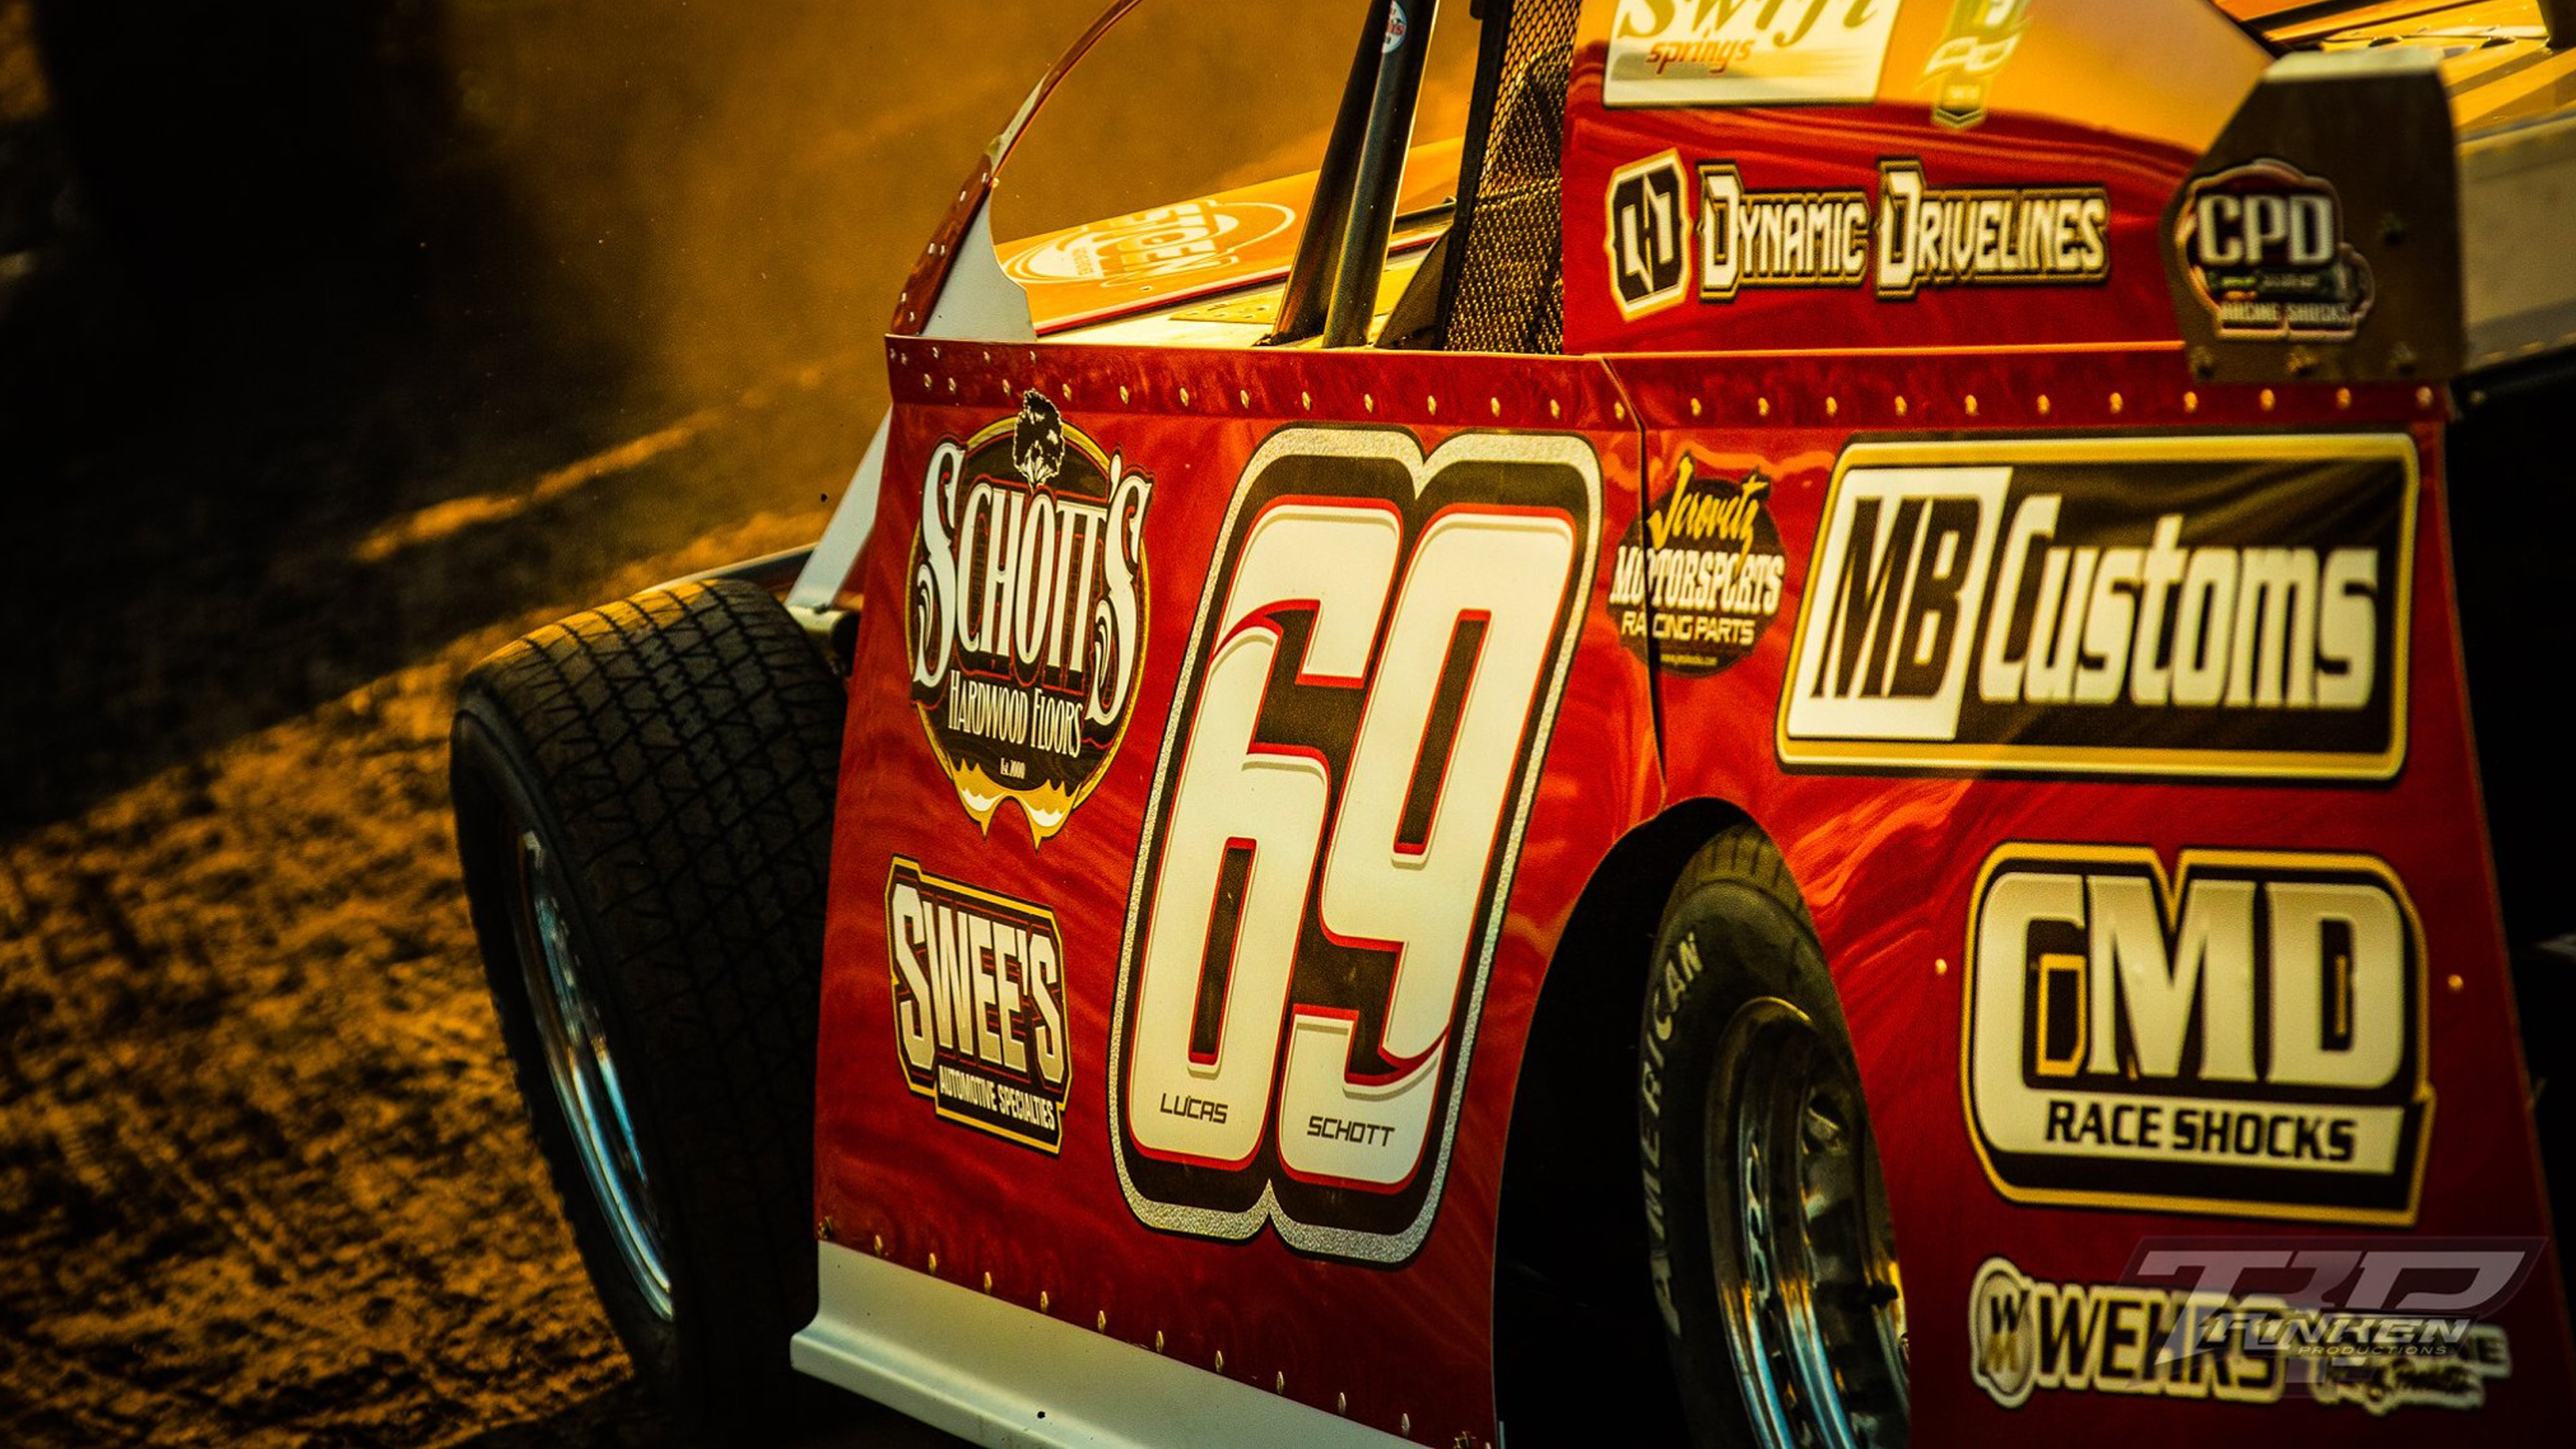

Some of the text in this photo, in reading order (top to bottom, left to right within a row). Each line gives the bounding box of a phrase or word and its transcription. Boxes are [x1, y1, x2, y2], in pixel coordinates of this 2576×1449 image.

[1646, 28, 1756, 74] springs
[1701, 169, 2105, 287] DYNAMIC DRIVELINES
[2198, 195, 2333, 265] CPD
[912, 439, 1152, 725] SCHOTT'S
[1609, 545, 1785, 616] MOTORSPORTS
[1809, 494, 2379, 710] MB Customs
[1621, 610, 1756, 645] RACING PARTS
[948, 669, 1083, 758] HARDWOOD FLOORS
[1127, 504, 1573, 1183] 69
[892, 883, 1065, 1084] SWEE'S
[938, 1064, 1056, 1132] AUTOMOTIVE SPECIALTIES
[1160, 1093, 1228, 1124] LUCAS
[1307, 1116, 1395, 1146] SCHOTT
[2046, 1099, 2359, 1163] RACE SHOCKS
[1640, 932, 1704, 1340] AMERICAN
